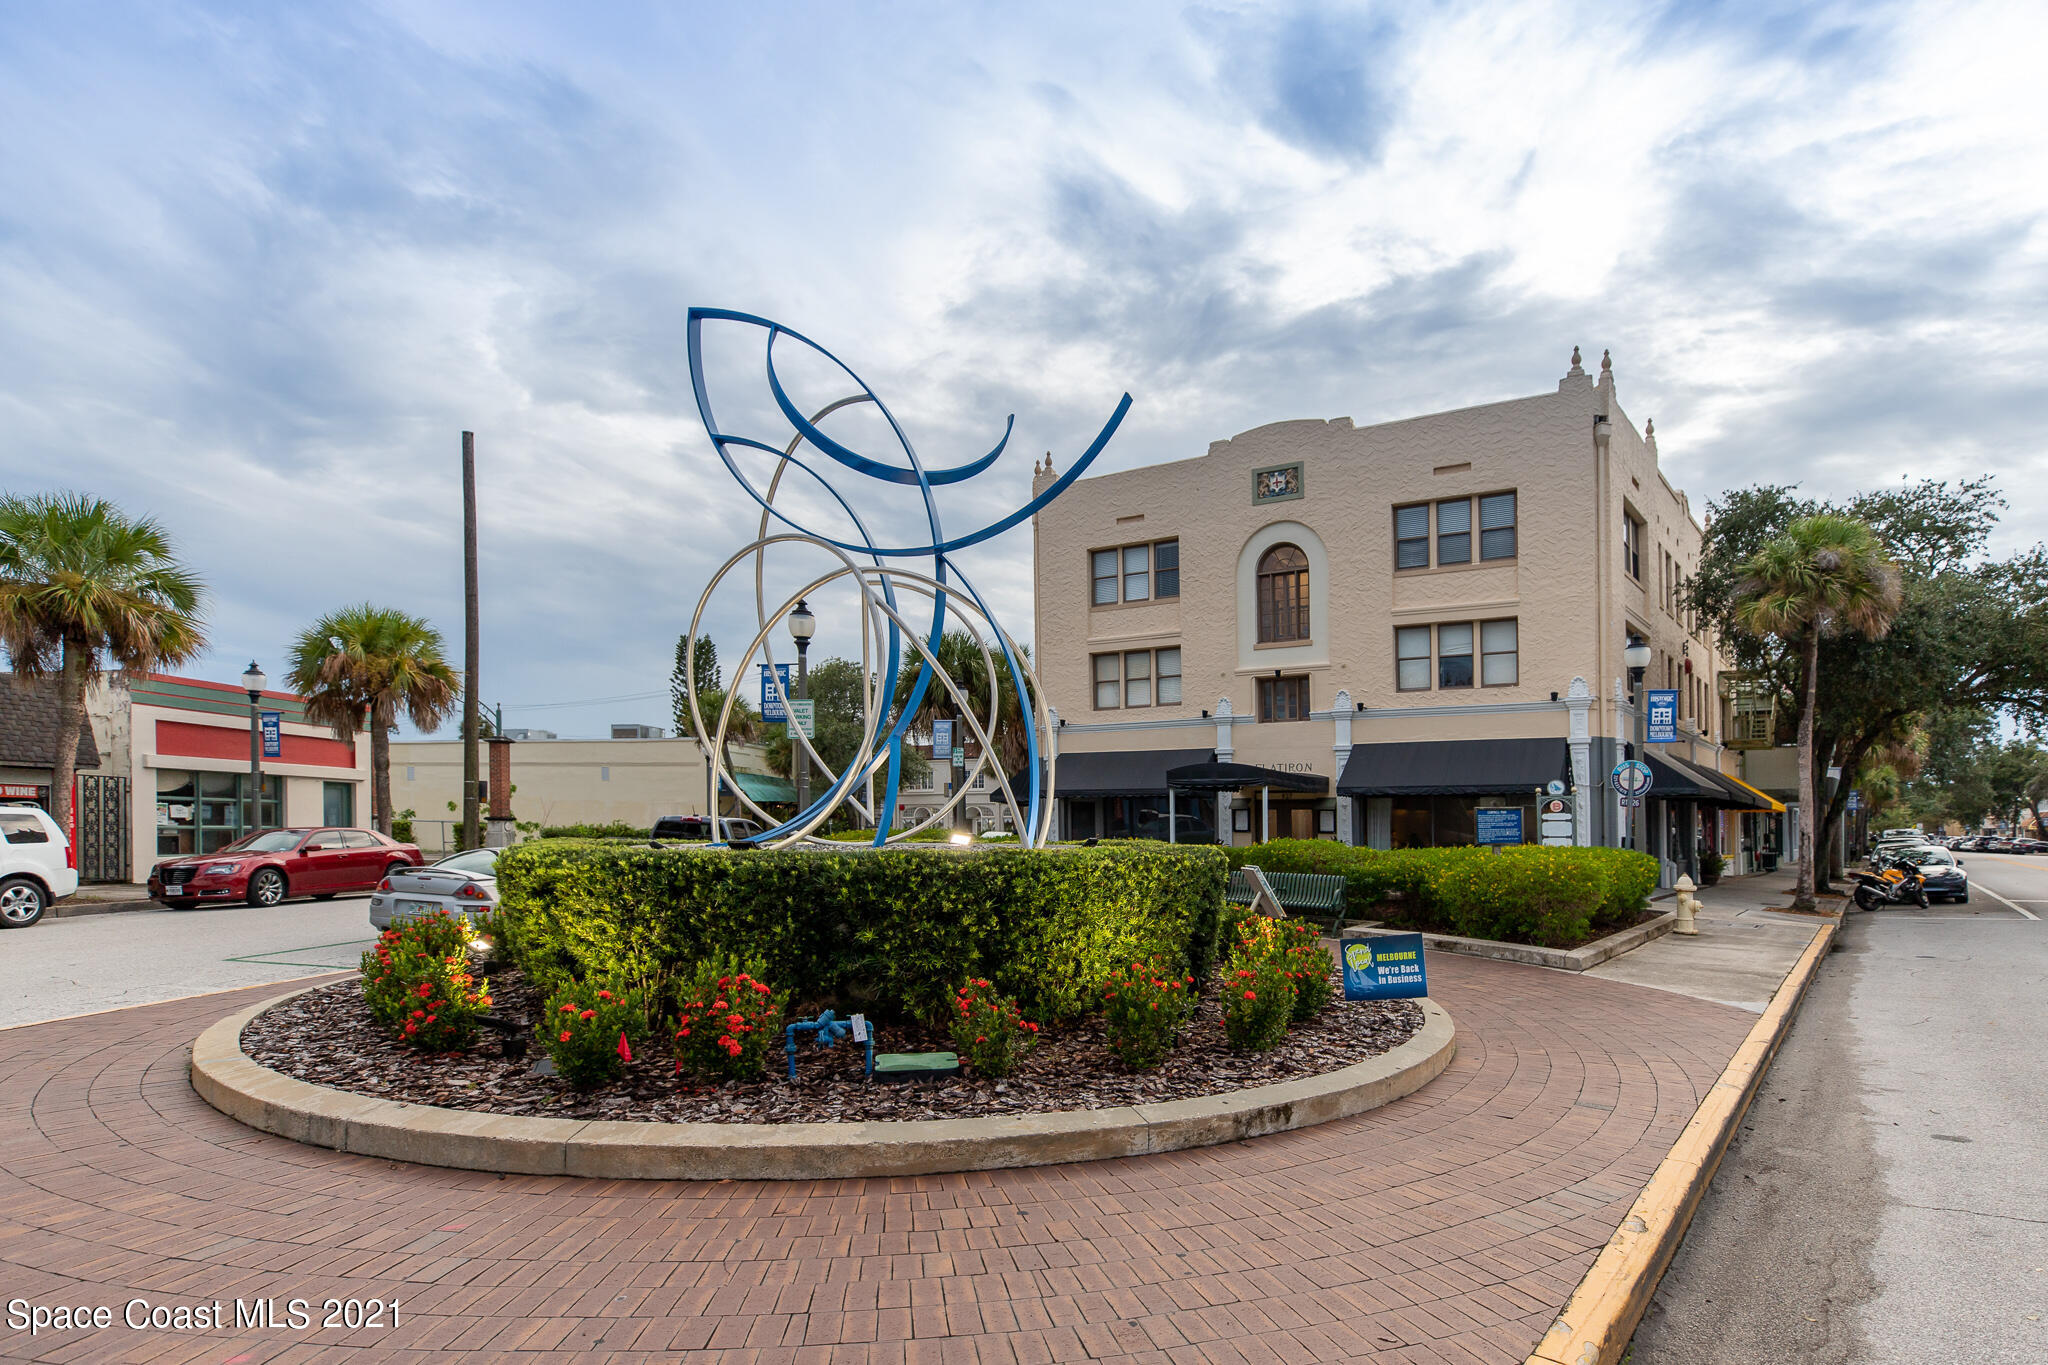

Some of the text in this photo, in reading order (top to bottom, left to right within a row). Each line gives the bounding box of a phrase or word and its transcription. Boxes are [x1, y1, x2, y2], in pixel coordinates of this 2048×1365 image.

[1617, 762, 1630, 772] BUS
[5, 786, 36, 796] WINE
[1376, 951, 1417, 962] MELBOURNE
[1377, 964, 1420, 975] We're Back
[1387, 974, 1423, 984] Business
